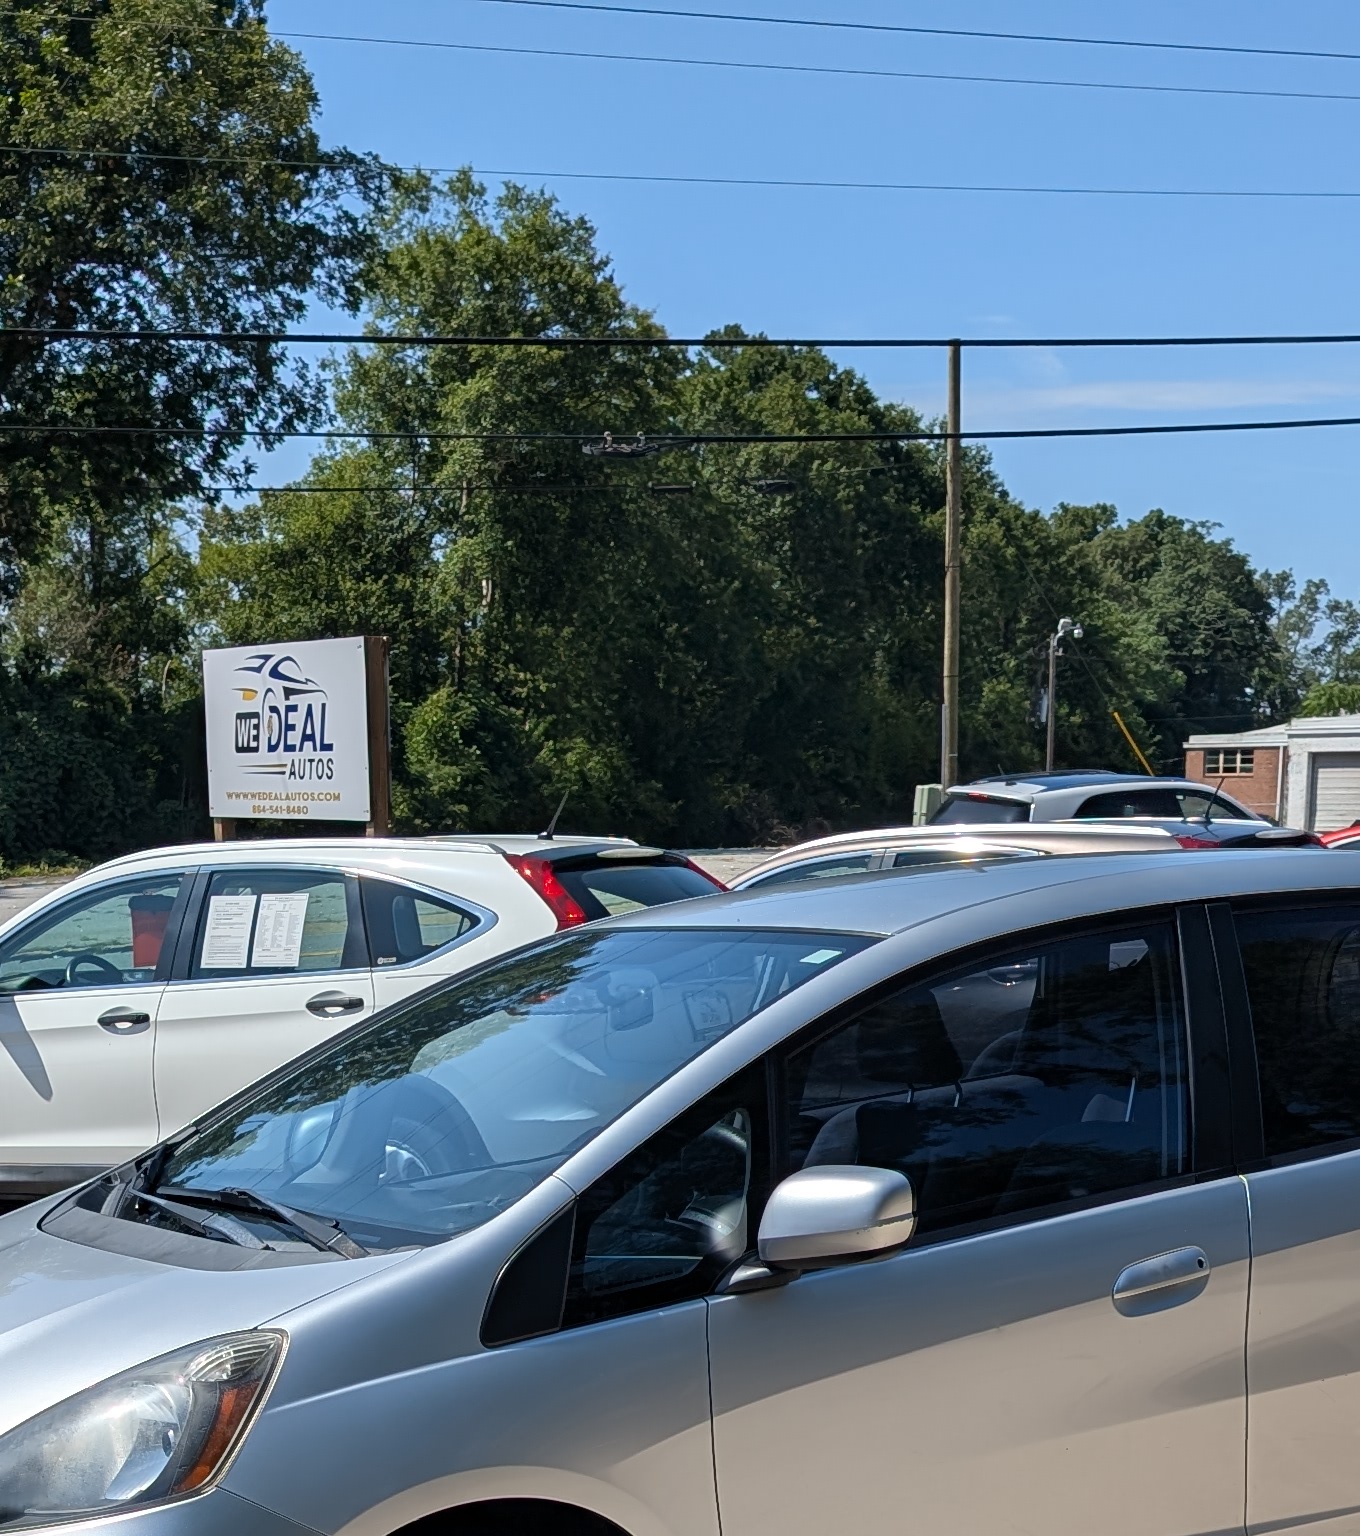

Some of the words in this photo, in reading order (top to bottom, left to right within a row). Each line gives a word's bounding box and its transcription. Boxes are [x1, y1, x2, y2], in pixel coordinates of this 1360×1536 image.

[237, 718, 258, 748] WE
[267, 703, 334, 753] DEAL
[288, 758, 334, 780] AUTOS
[226, 791, 341, 802] WWW.WEDEALAUTOS.COM
[252, 804, 309, 815] 864-541-8480
